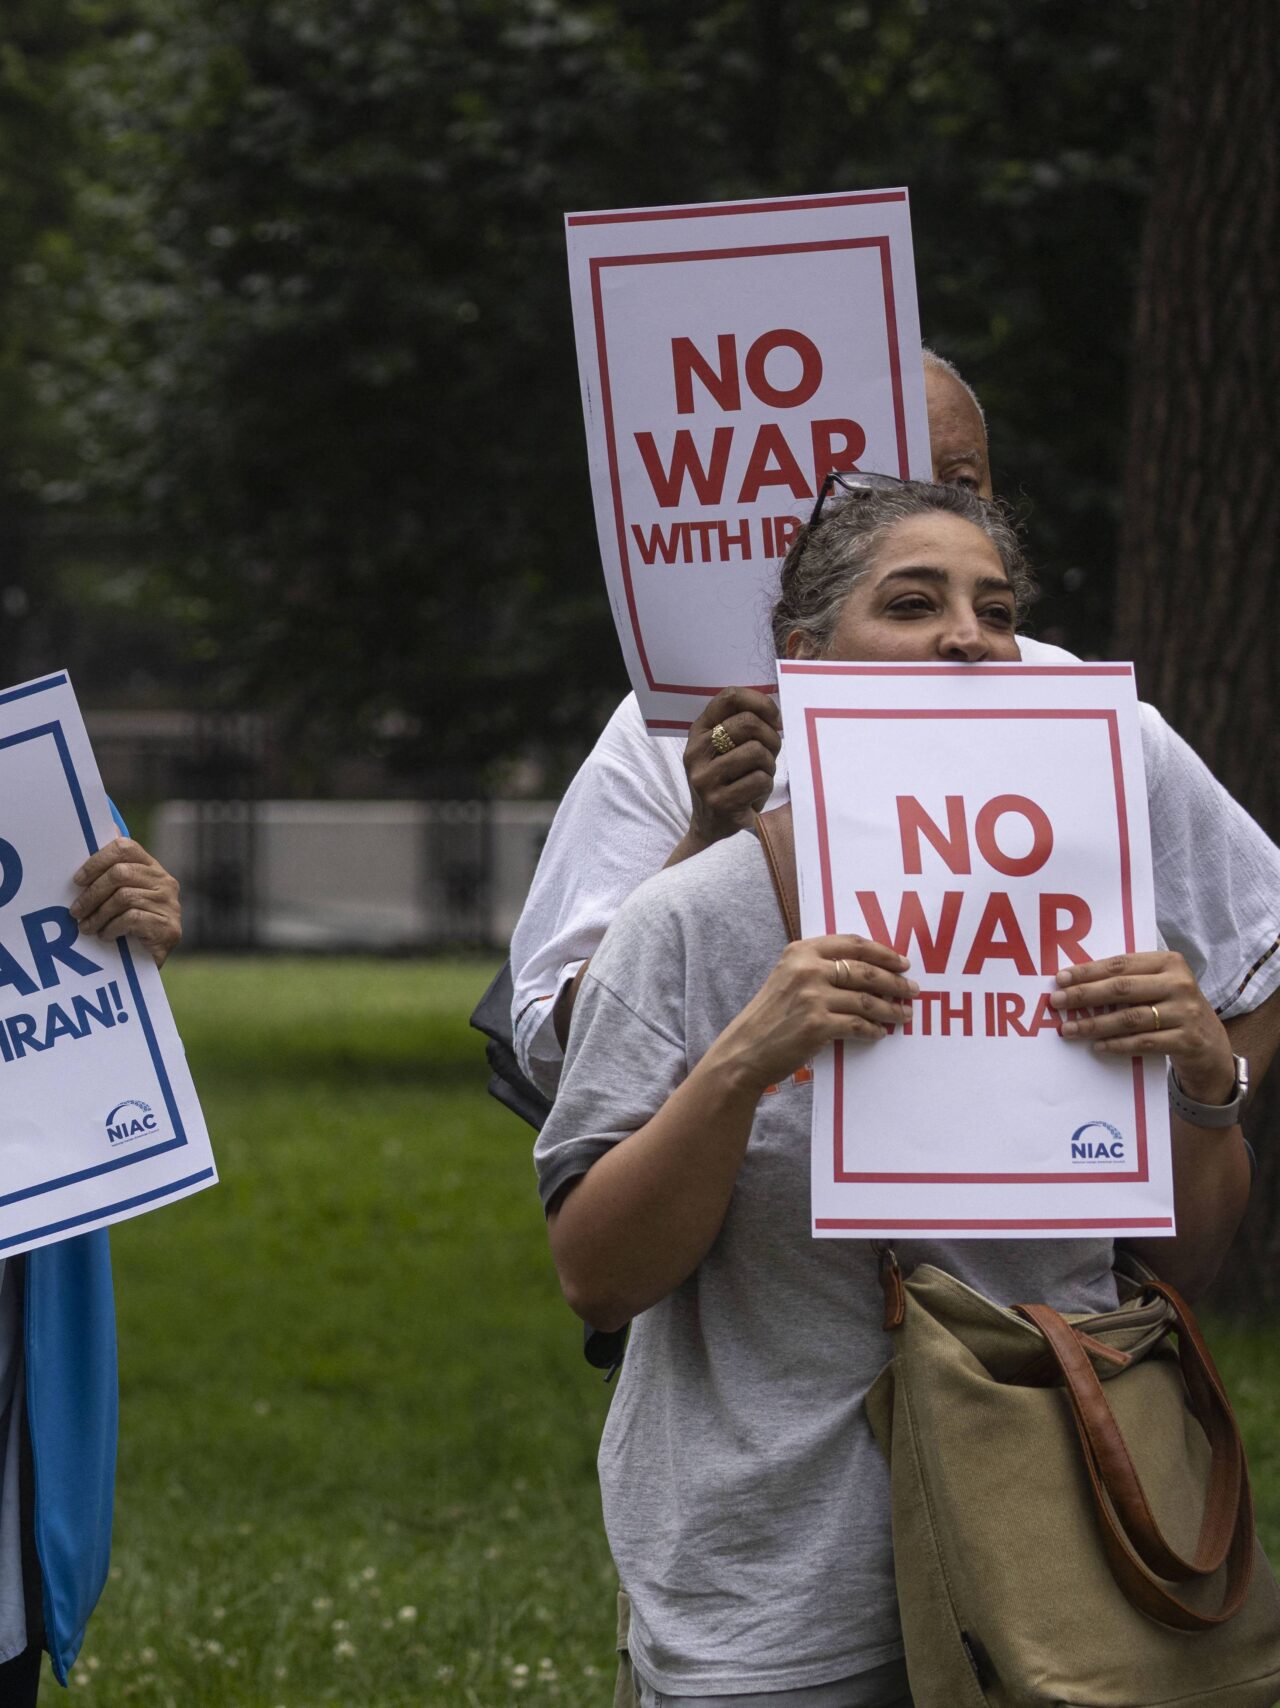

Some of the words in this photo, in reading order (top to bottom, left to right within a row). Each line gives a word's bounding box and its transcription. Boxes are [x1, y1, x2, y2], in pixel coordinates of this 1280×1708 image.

[671, 328, 823, 414] NO
[633, 418, 866, 508] WAR
[631, 518, 753, 565] WITH
[895, 794, 1054, 877] NO
[855, 890, 1095, 977] WAR
[882, 990, 974, 1037] TH
[106, 1113, 158, 1143] NIAC
[1071, 1142, 1125, 1159] NIAC
